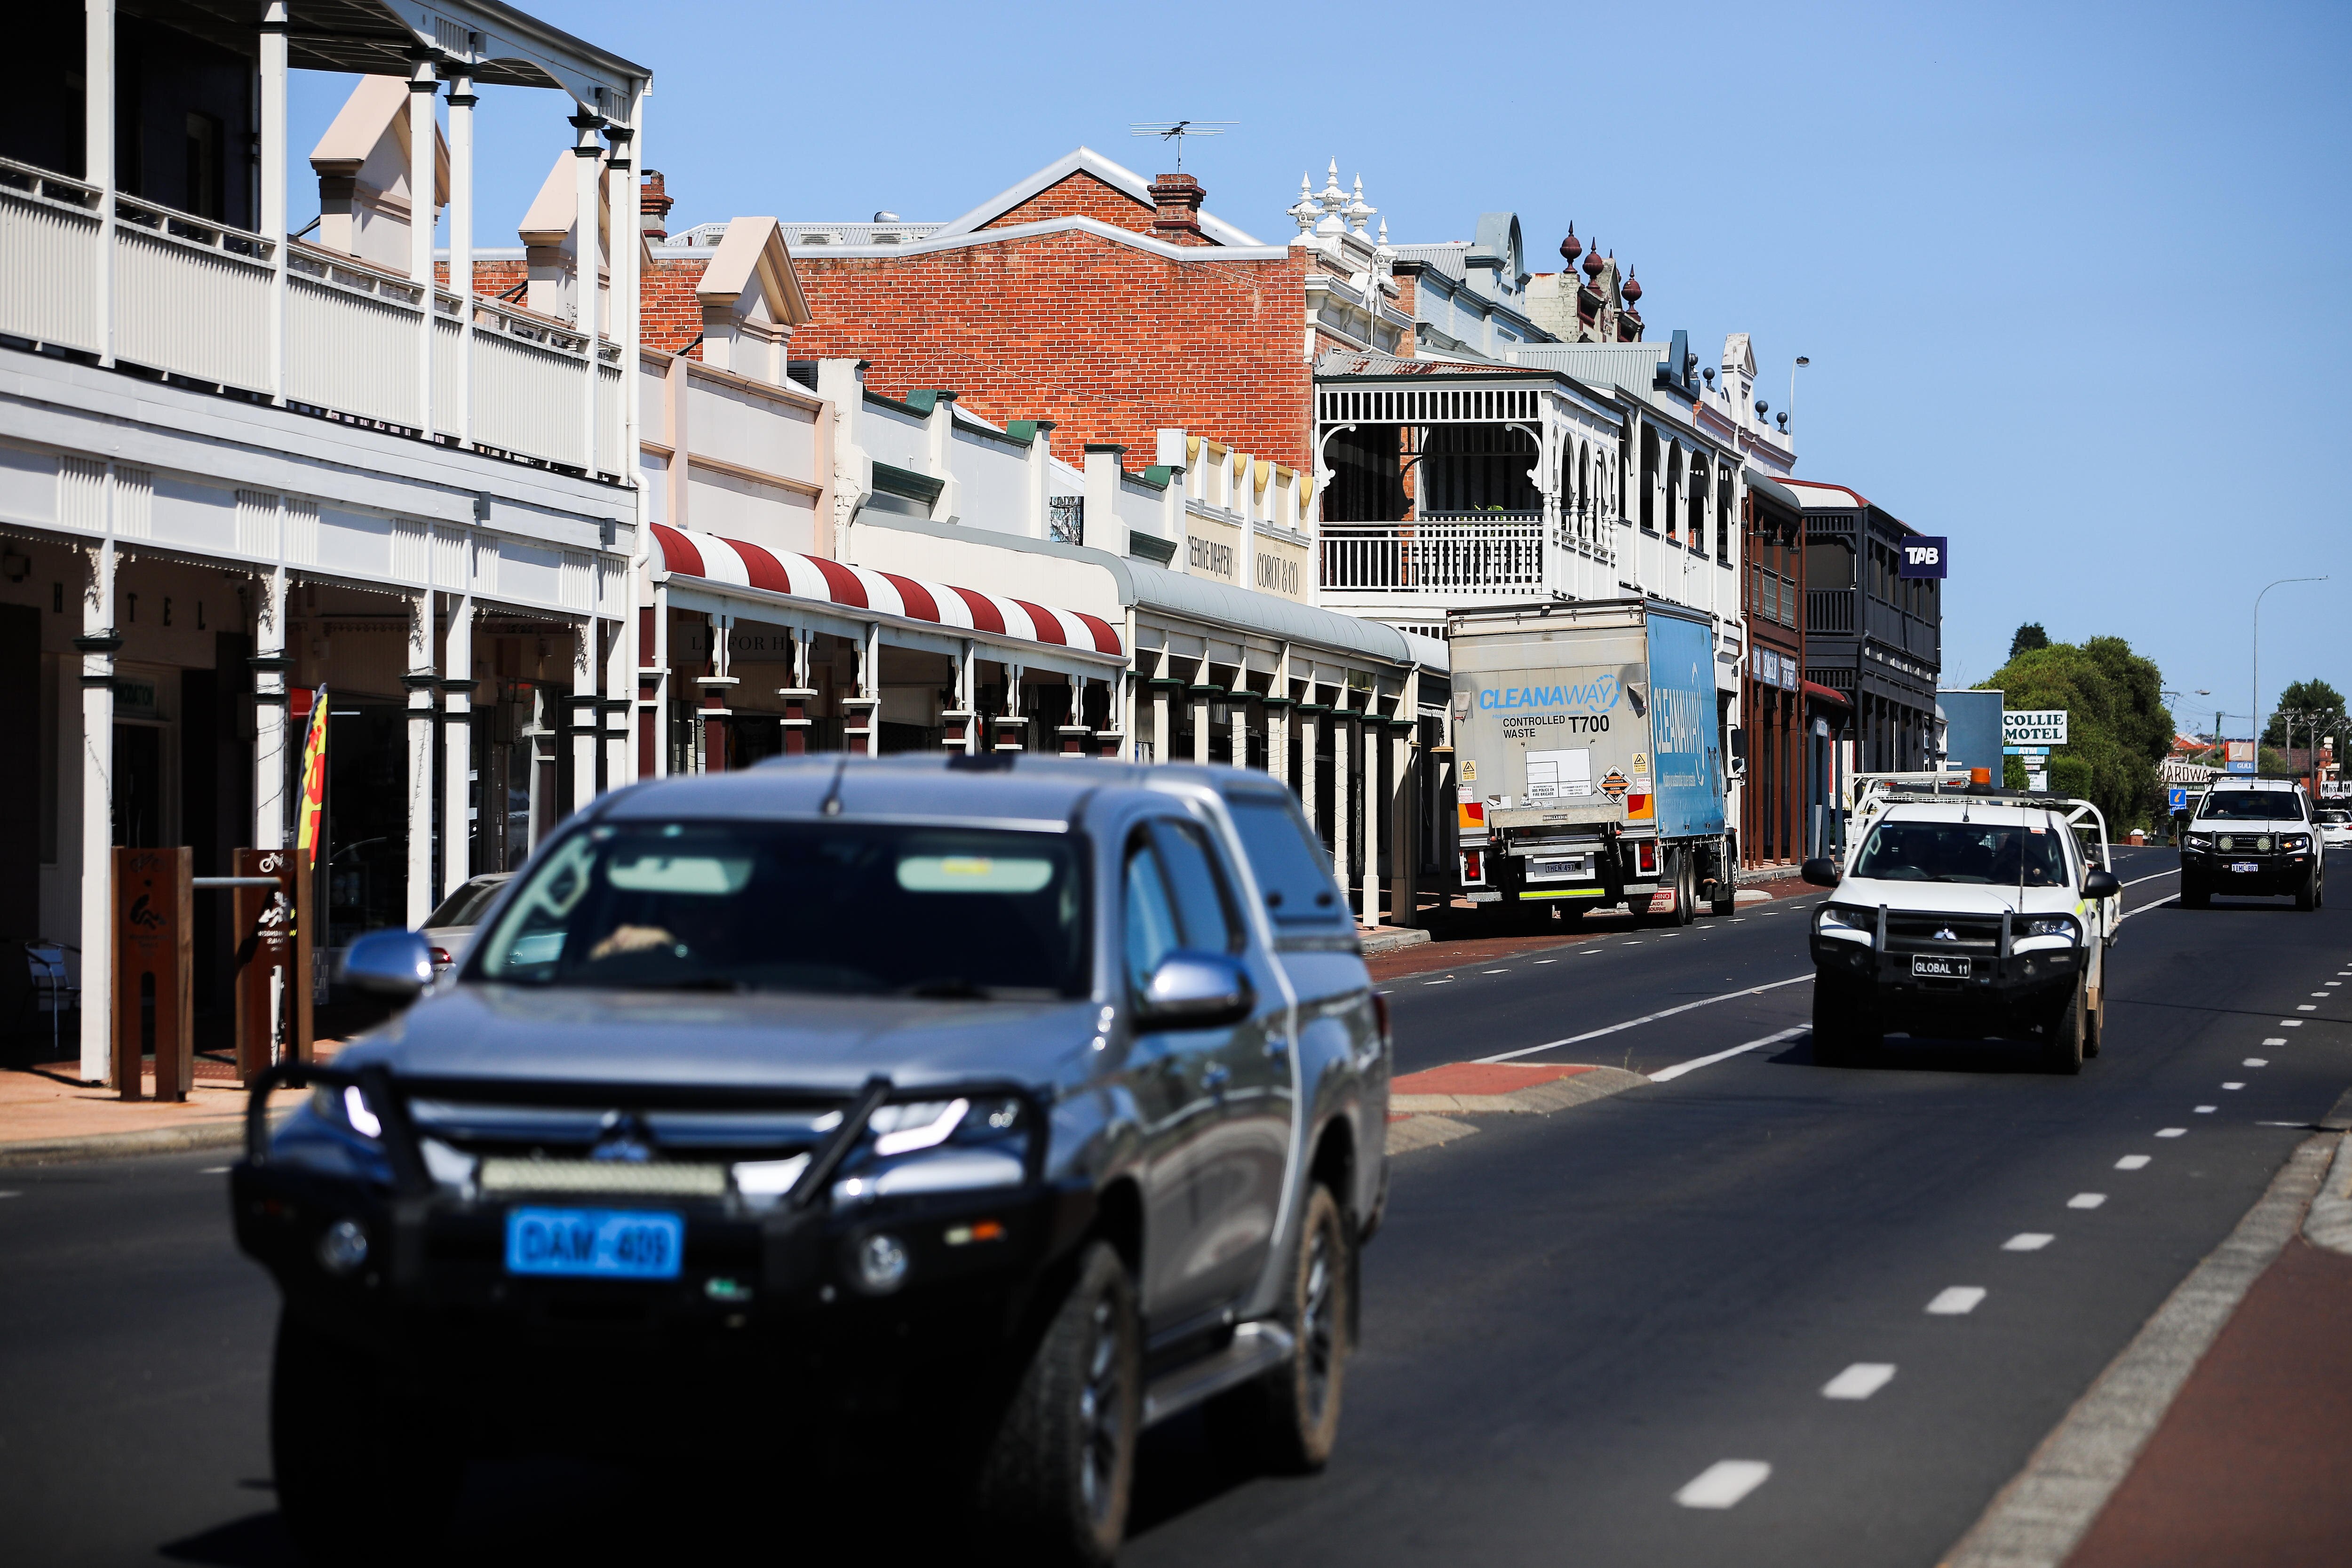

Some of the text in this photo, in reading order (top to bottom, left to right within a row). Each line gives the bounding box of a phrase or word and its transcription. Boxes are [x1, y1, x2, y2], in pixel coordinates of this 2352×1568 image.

[1210, 542, 1233, 580] DRAPERY
[1905, 547, 1939, 565] TAB
[1257, 552, 1298, 595] COROT & CO
[53, 582, 206, 630] HTEL
[1479, 684, 1613, 710] CLEANAWAY
[1503, 715, 1565, 727] CONTROLLED
[1568, 715, 1610, 733] T700
[1653, 687, 1700, 755] CLEANAWAY
[2003, 715, 2063, 725] COLLIE
[1503, 728, 1536, 738] WASTE
[2005, 729, 2062, 739] MOTEL
[1915, 962, 1968, 974] GLOBAL 11
